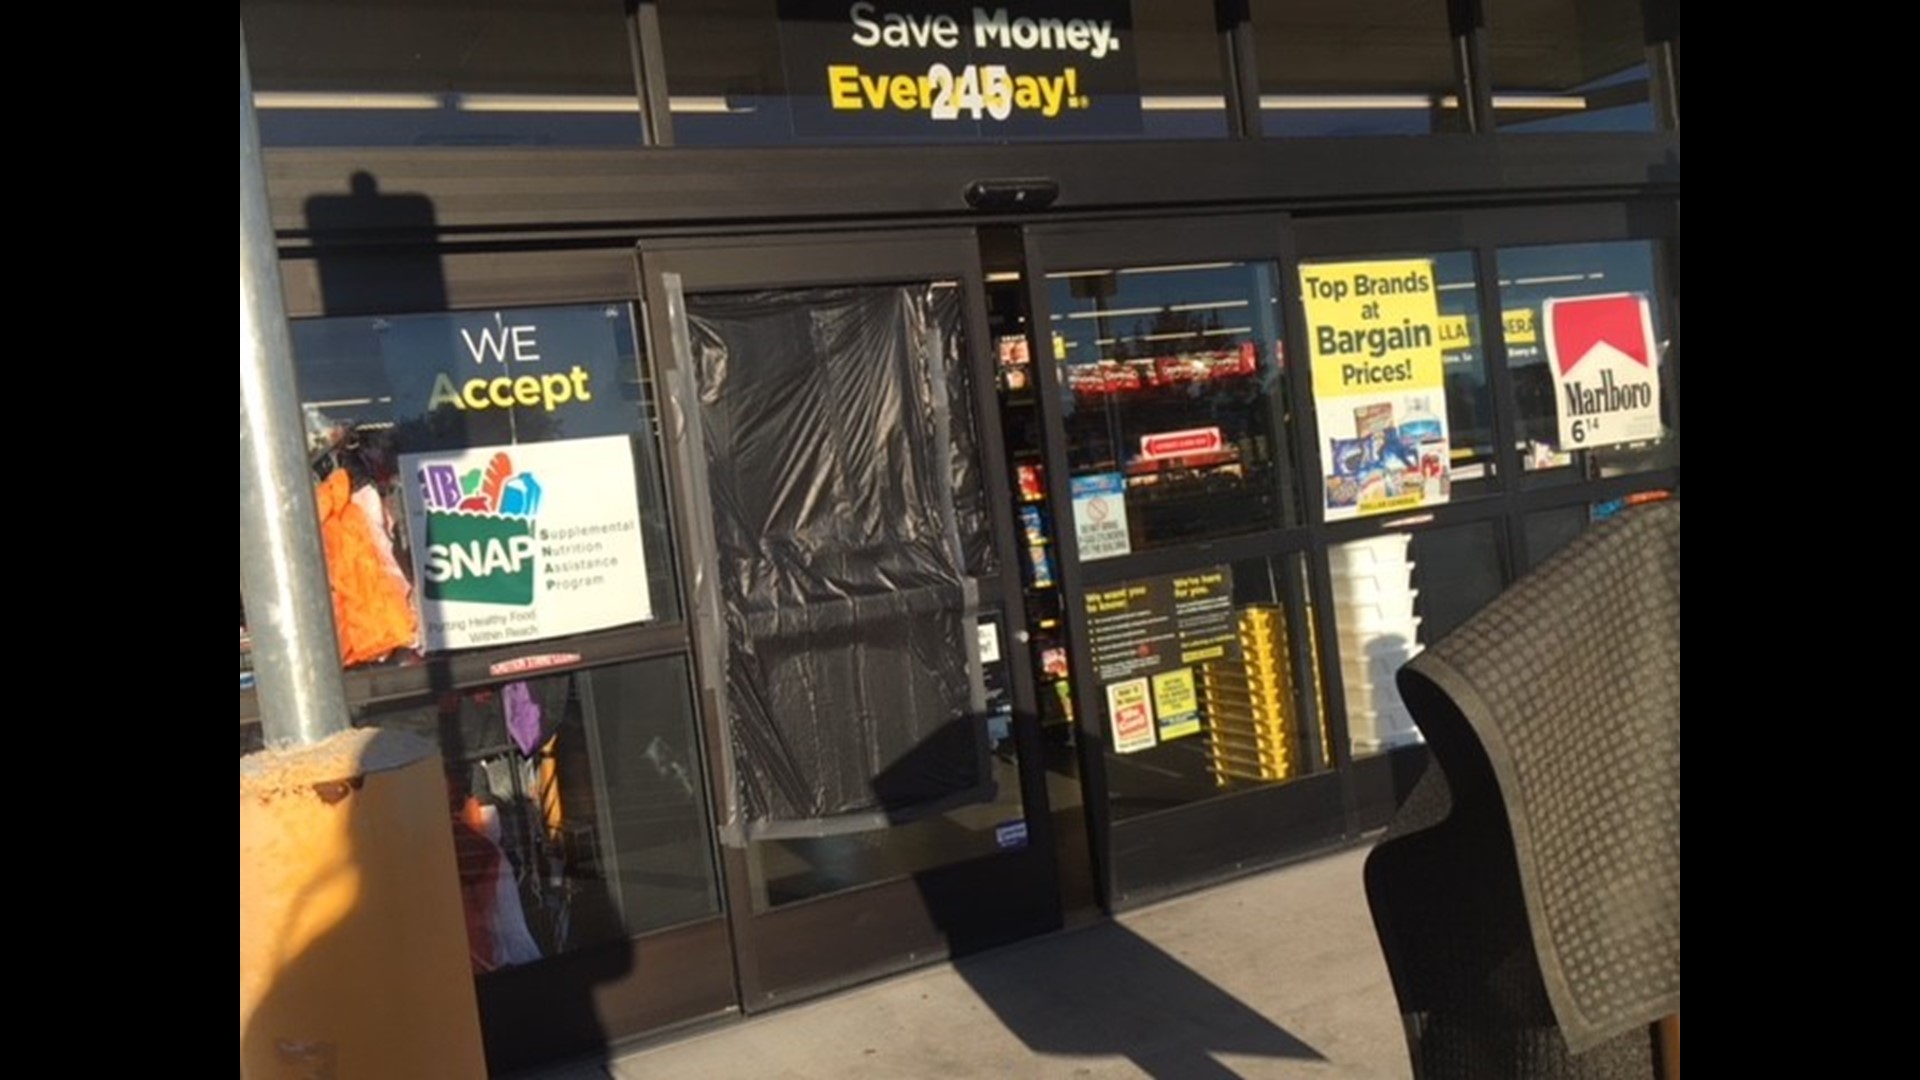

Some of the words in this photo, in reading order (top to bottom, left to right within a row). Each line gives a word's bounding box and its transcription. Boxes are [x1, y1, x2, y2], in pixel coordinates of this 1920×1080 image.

[850, 3, 958, 48] Save
[973, 8, 1120, 58] Money.
[928, 63, 1013, 120] 245
[1306, 276, 1348, 302] Top
[1354, 272, 1429, 297] Brands
[1361, 301, 1380, 320] at
[462, 326, 540, 364] WE
[1316, 319, 1433, 356] Bargain
[1341, 358, 1413, 386] Prices!
[428, 366, 592, 411] Accept
[1564, 368, 1652, 418] Marlboro
[540, 519, 634, 540] Supplemental
[424, 536, 536, 582] SNAP
[542, 541, 603, 557] Nutrition
[545, 557, 618, 574] Assistance
[546, 575, 605, 591] Program
[469, 613, 507, 628] Healthy
[510, 610, 536, 623] Food
[469, 629, 503, 643] Within
[505, 625, 539, 638] Reach
